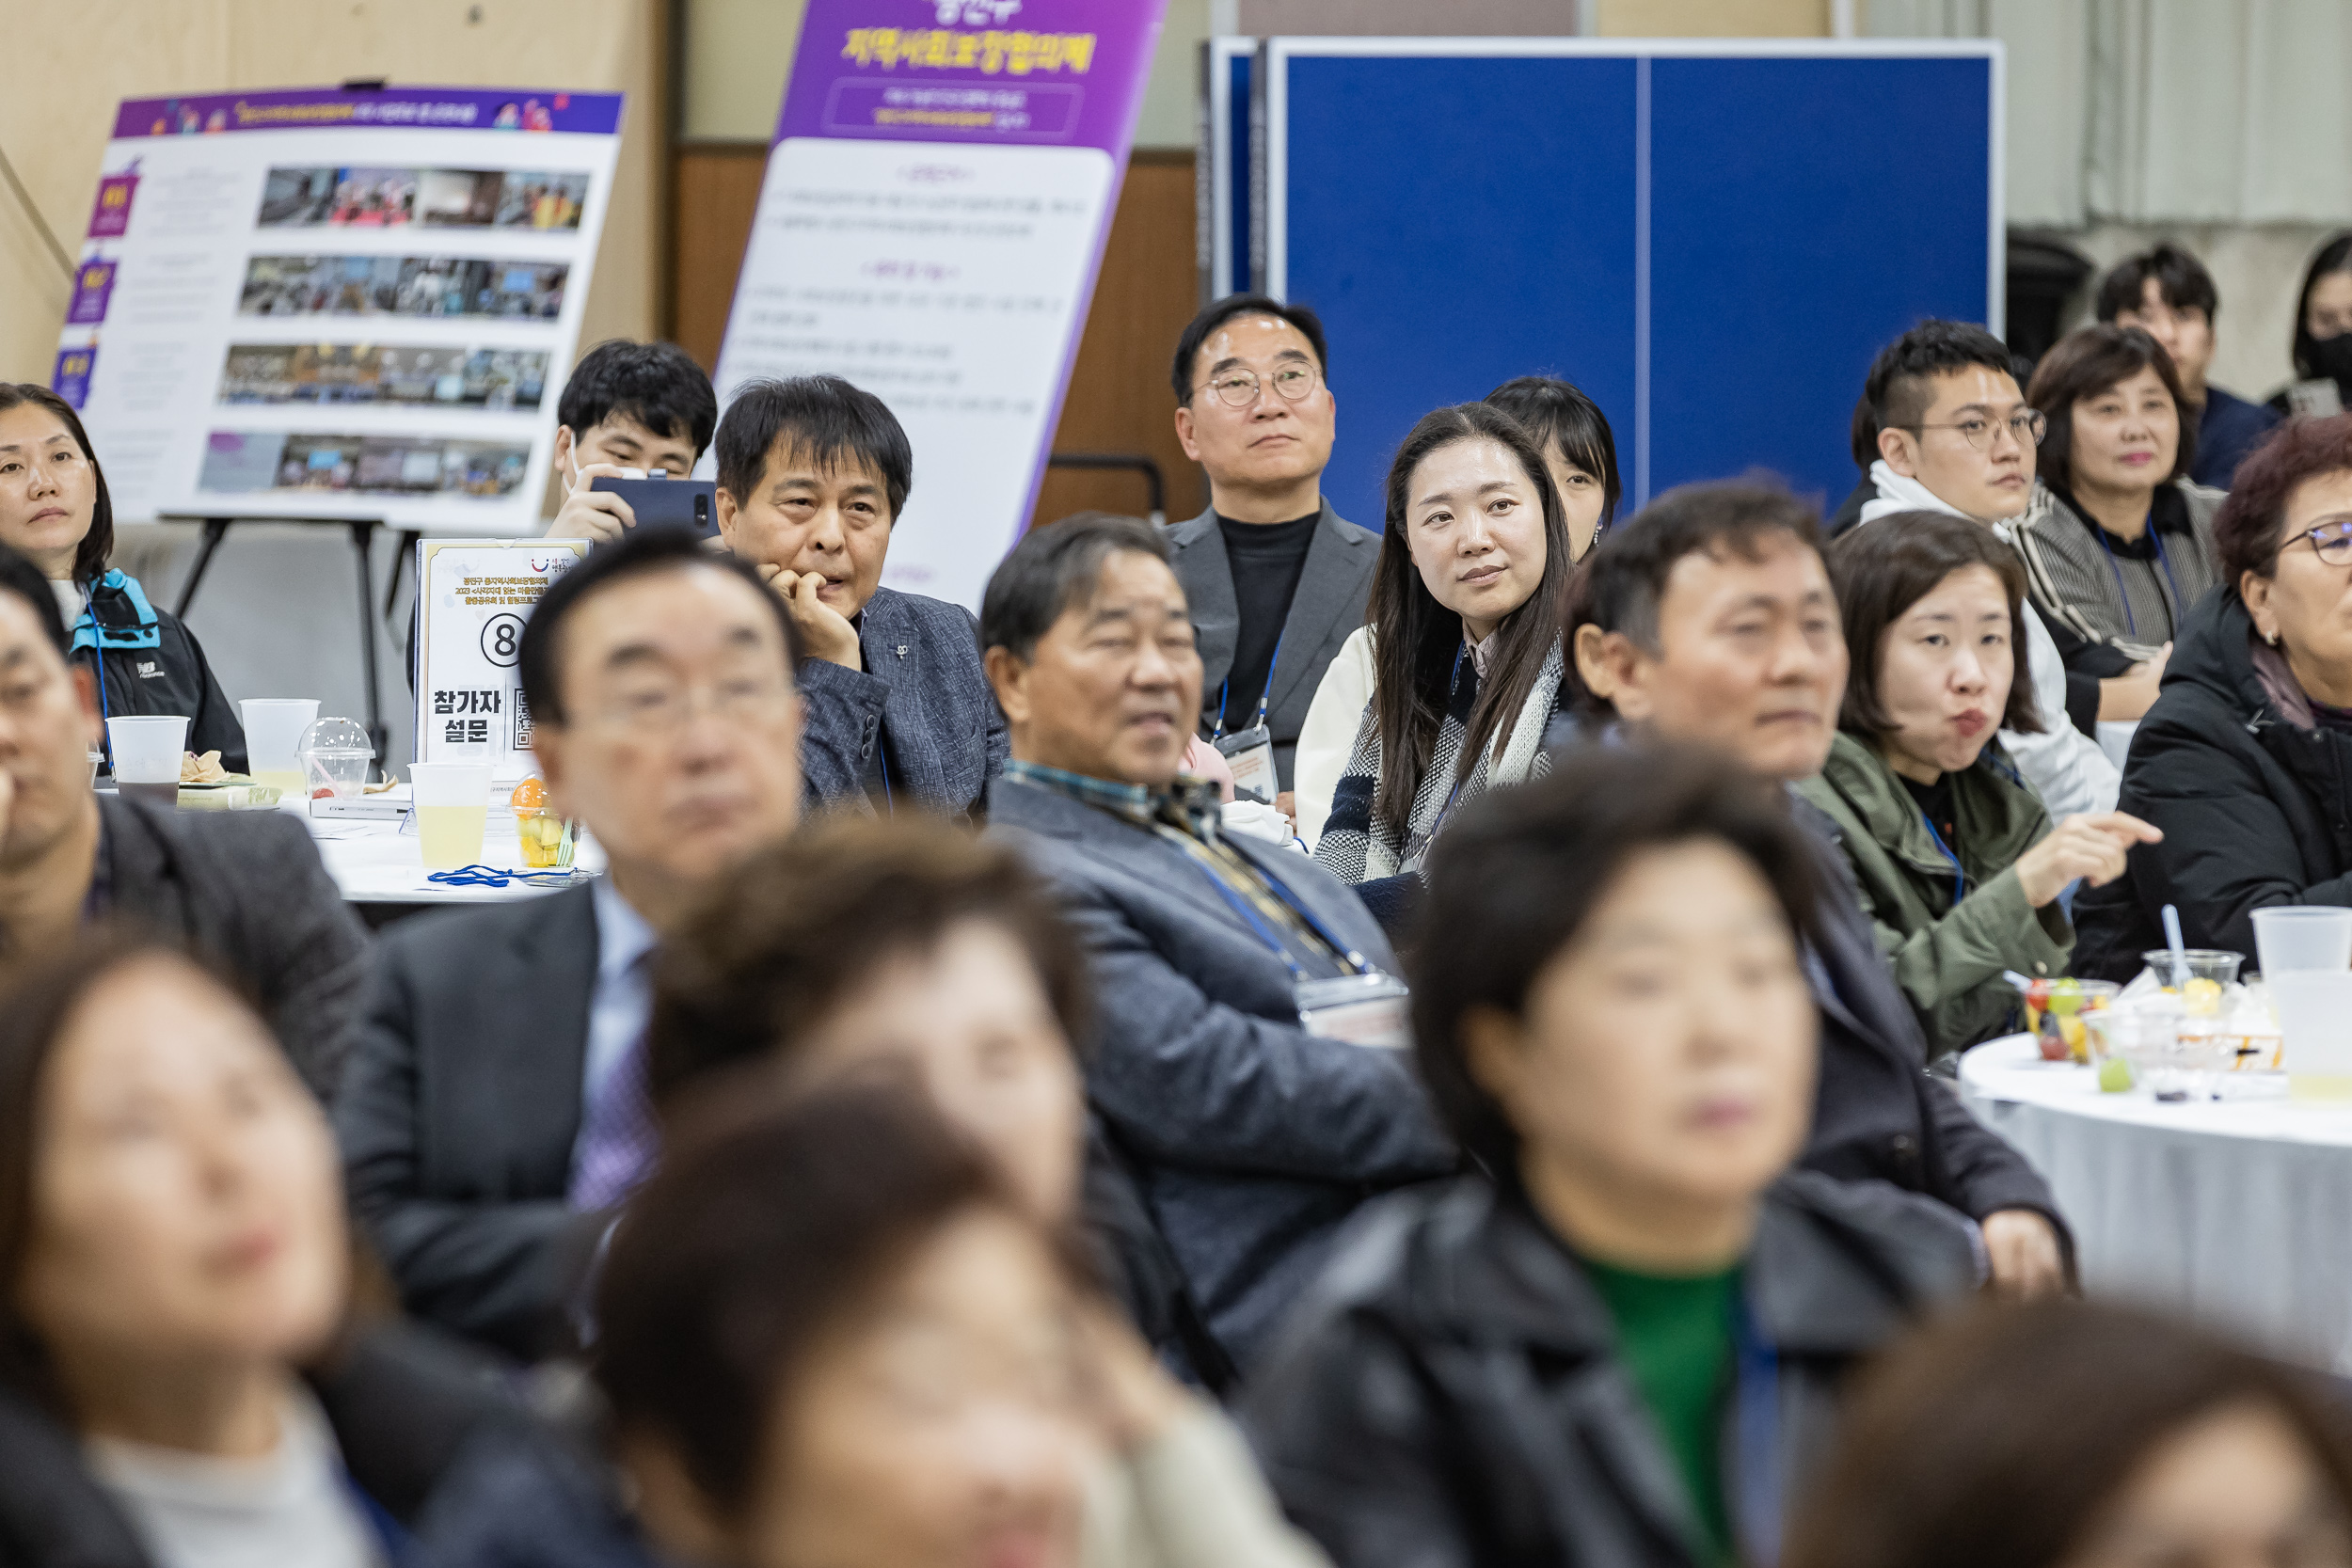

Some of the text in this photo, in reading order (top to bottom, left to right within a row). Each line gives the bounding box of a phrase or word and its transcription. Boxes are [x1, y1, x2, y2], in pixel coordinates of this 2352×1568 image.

[499, 596, 505, 605] 및
[507, 596, 538, 605] 힐링프로그
[503, 586, 516, 594] 없는
[495, 624, 516, 657] 8
[434, 689, 501, 715] 참가자
[445, 720, 488, 743] 설문
